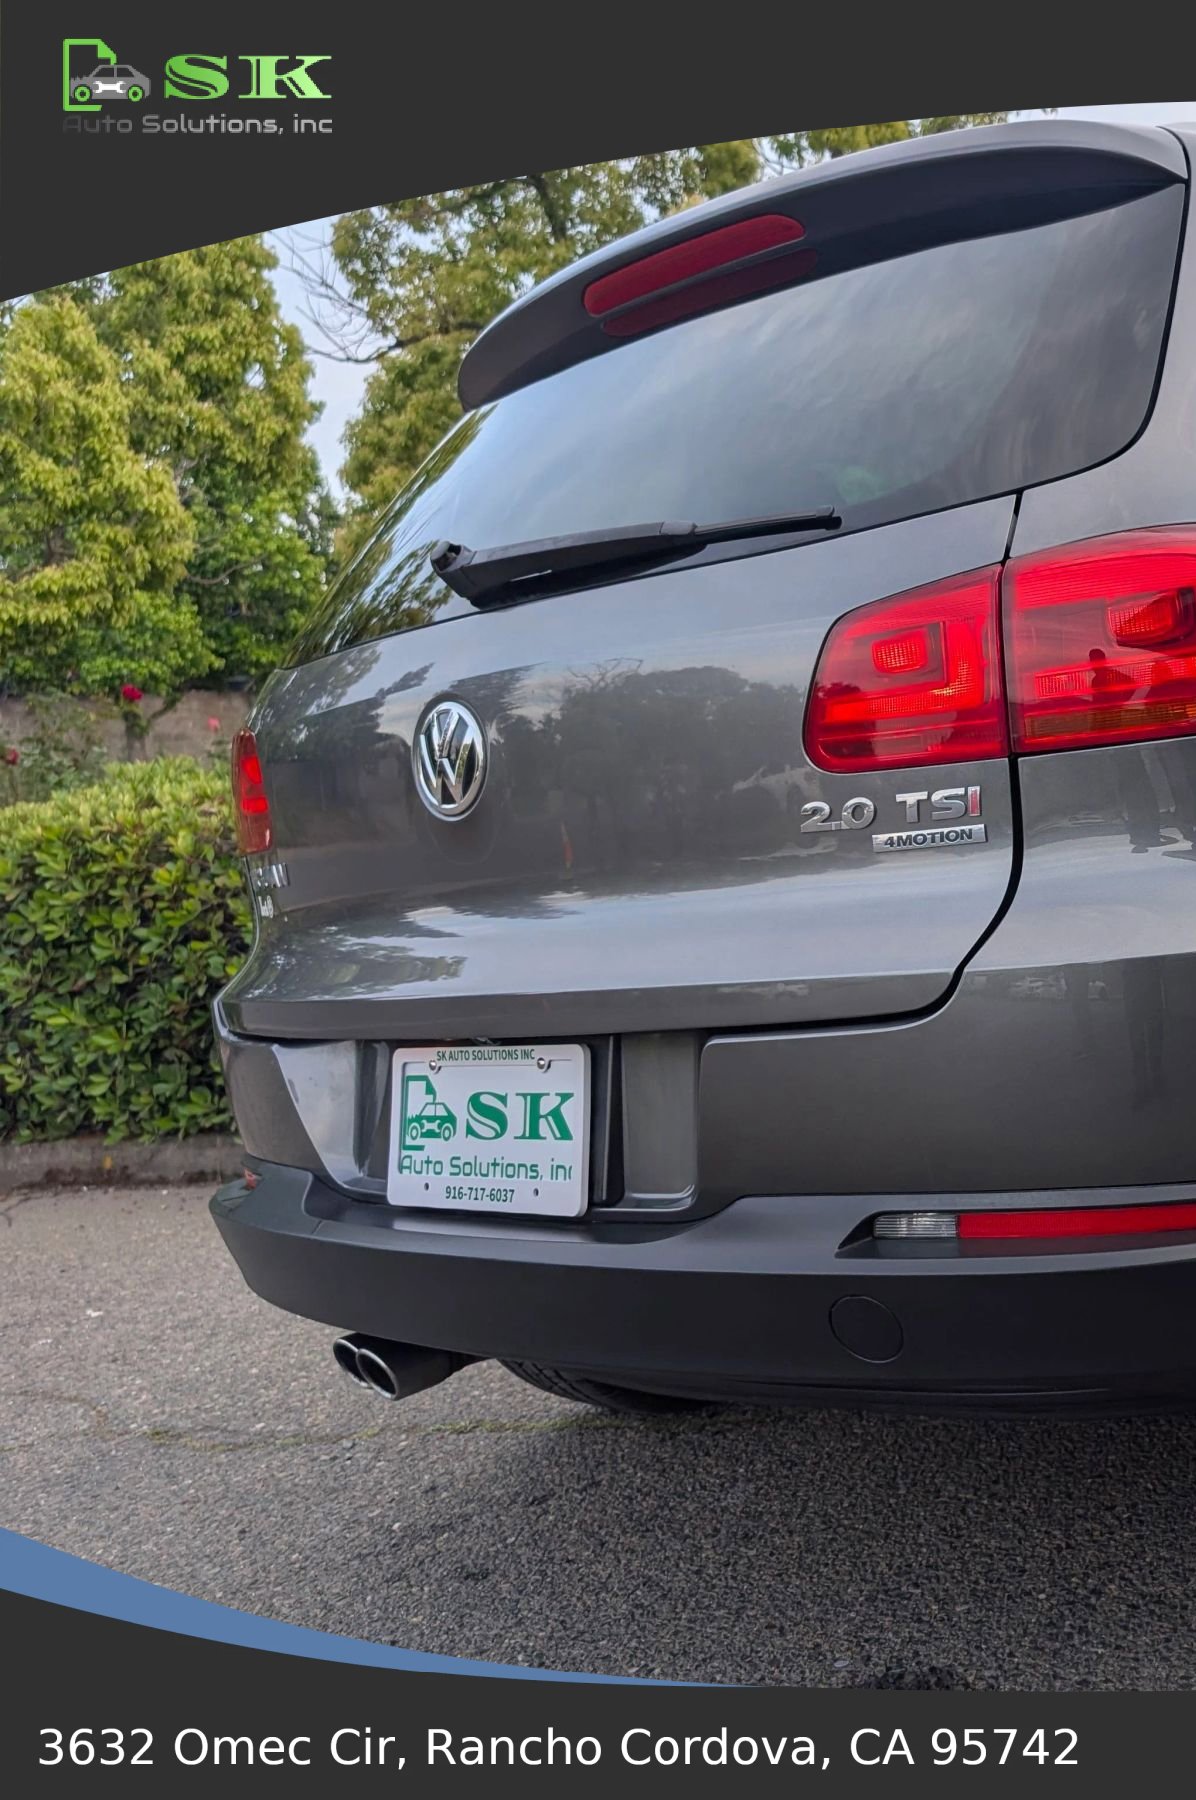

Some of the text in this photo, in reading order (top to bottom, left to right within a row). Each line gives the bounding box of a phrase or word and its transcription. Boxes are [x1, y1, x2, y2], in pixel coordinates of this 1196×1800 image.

[800, 785, 981, 833] 2.0 TSI
[883, 828, 973, 848] 4MOTION
[436, 1048, 536, 1062] SK AUTO SOLUTIONS INC
[465, 1091, 575, 1141] SK
[400, 1154, 444, 1176] Auto
[449, 1155, 544, 1181] Solutions,
[444, 1185, 516, 1203] 916-717-6037
